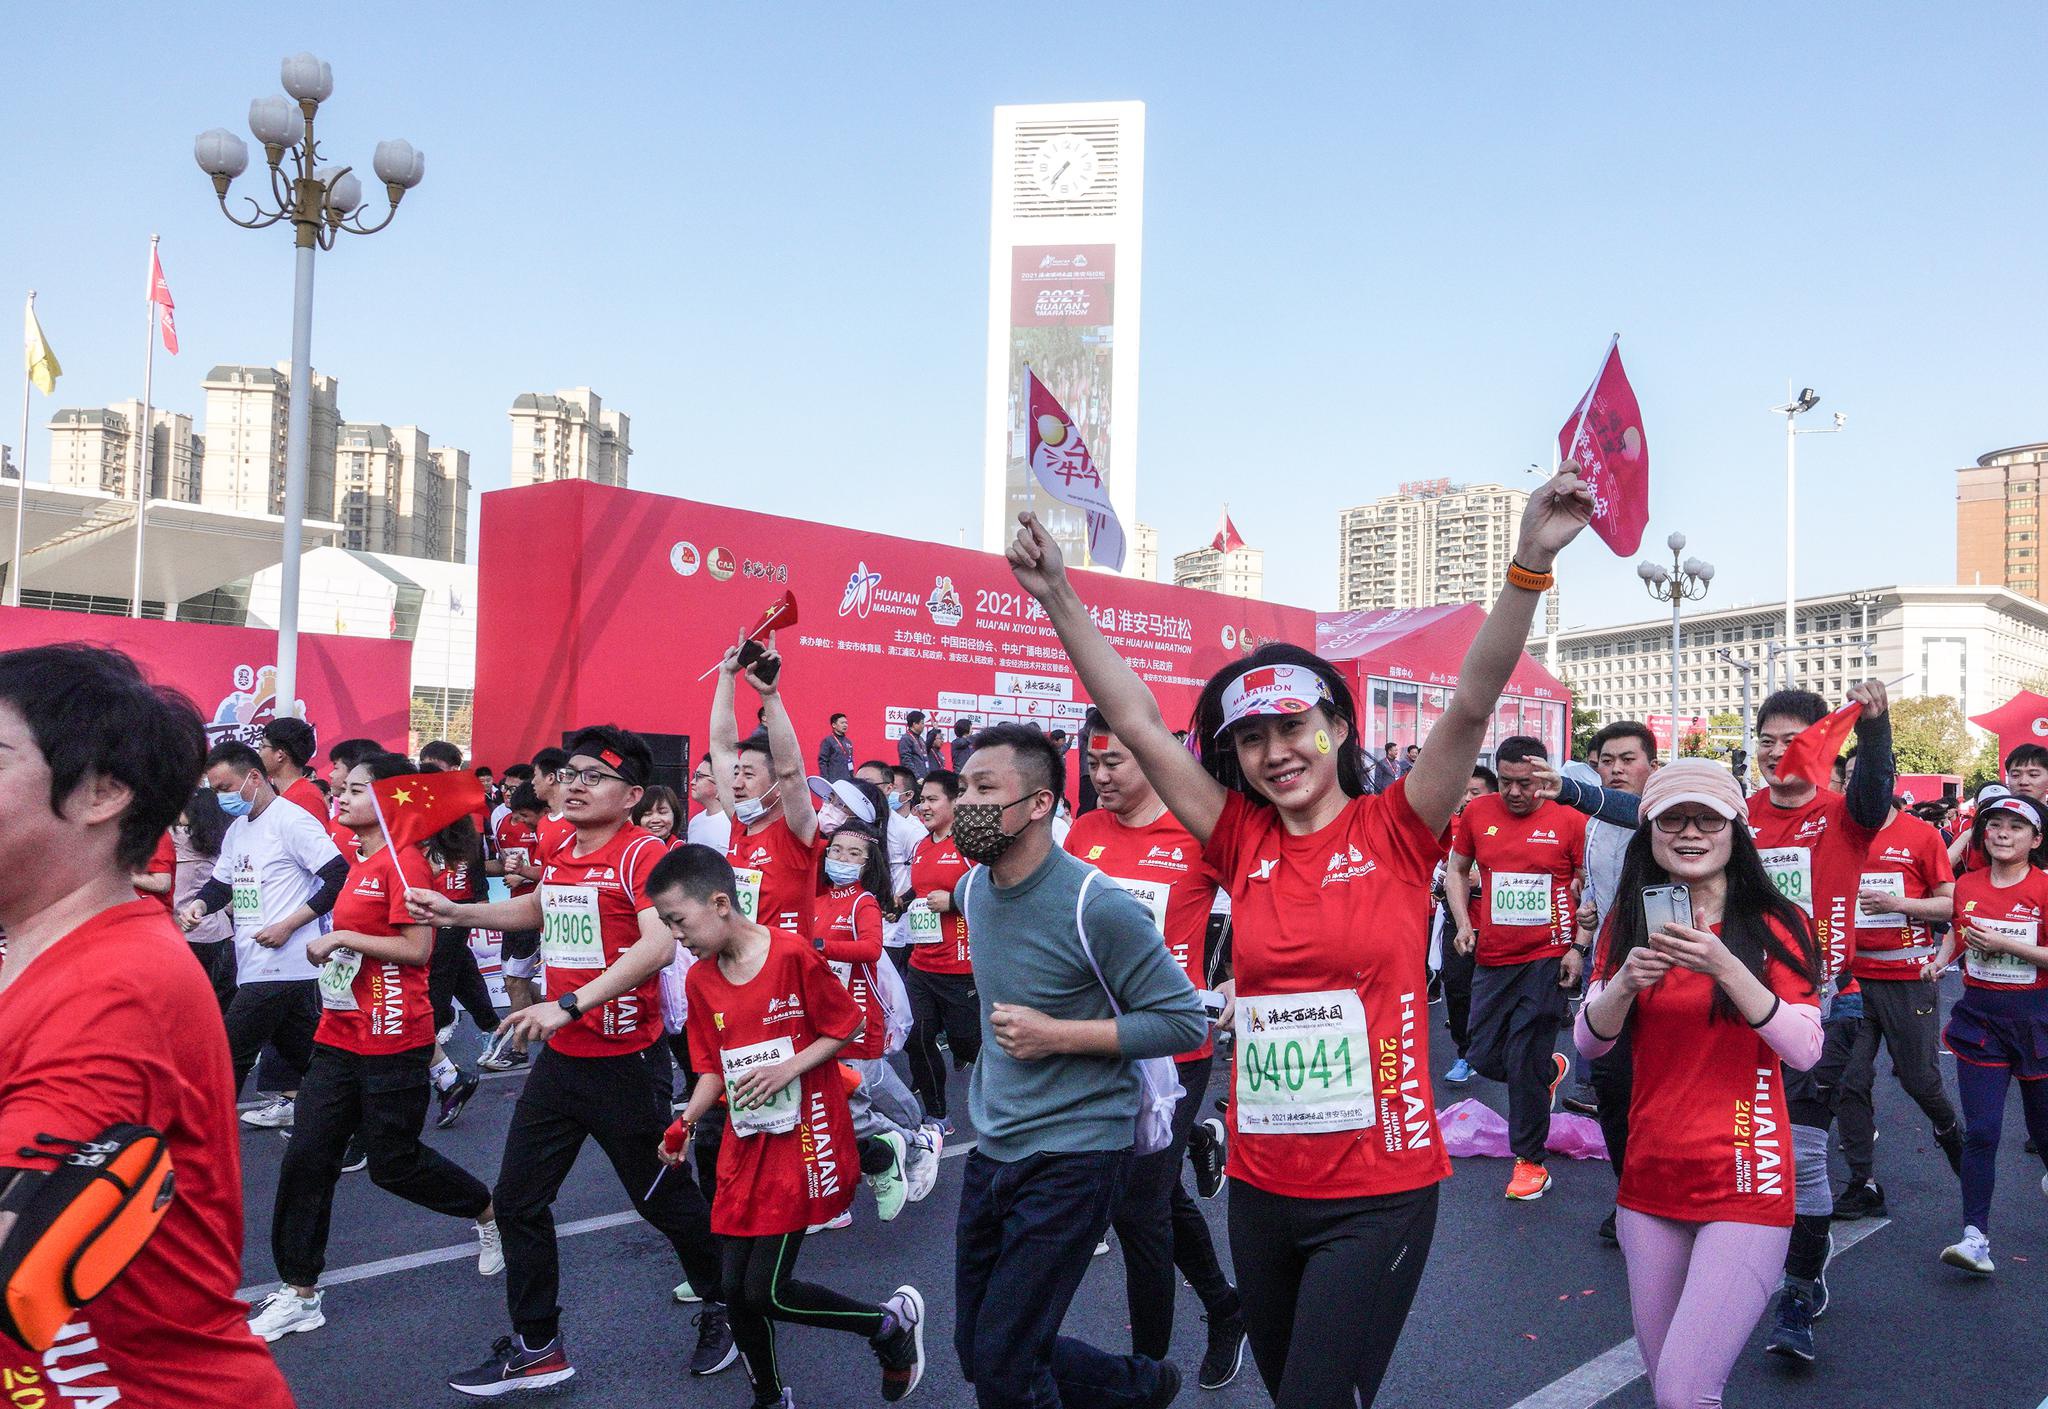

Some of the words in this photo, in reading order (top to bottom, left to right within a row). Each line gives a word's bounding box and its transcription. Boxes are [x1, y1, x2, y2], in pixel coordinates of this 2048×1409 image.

[872, 603, 917, 617] MARATHON
[875, 588, 920, 605] HUAI'AN
[976, 589, 1020, 617] 2021
[976, 618, 1010, 631] HUAI'AN
[1012, 623, 1037, 635] XIYOU
[1125, 638, 1153, 649] HUAI'AN
[1154, 641, 1192, 654] MARATHON
[1232, 684, 1292, 706] MARATHON
[1496, 890, 1546, 911] 00385
[544, 913, 593, 945] 01906
[371, 976, 382, 1006] 2021
[1268, 1004, 1344, 1025] 淮安西游乐园
[726, 1048, 780, 1070] 淮安西游乐园
[1246, 1036, 1353, 1093] 04041
[1379, 1038, 1398, 1095] 2021
[1400, 991, 1431, 1150] HUAIAN
[1271, 1113, 1286, 1122] 2021
[1380, 1098, 1394, 1152] MARATHON
[1734, 1099, 1751, 1147] 2021
[1753, 1068, 1783, 1195] HUAIAN
[801, 1124, 816, 1162] 2021
[812, 1091, 840, 1197] HUAIAN
[1735, 1148, 1743, 1193] MARATHON
